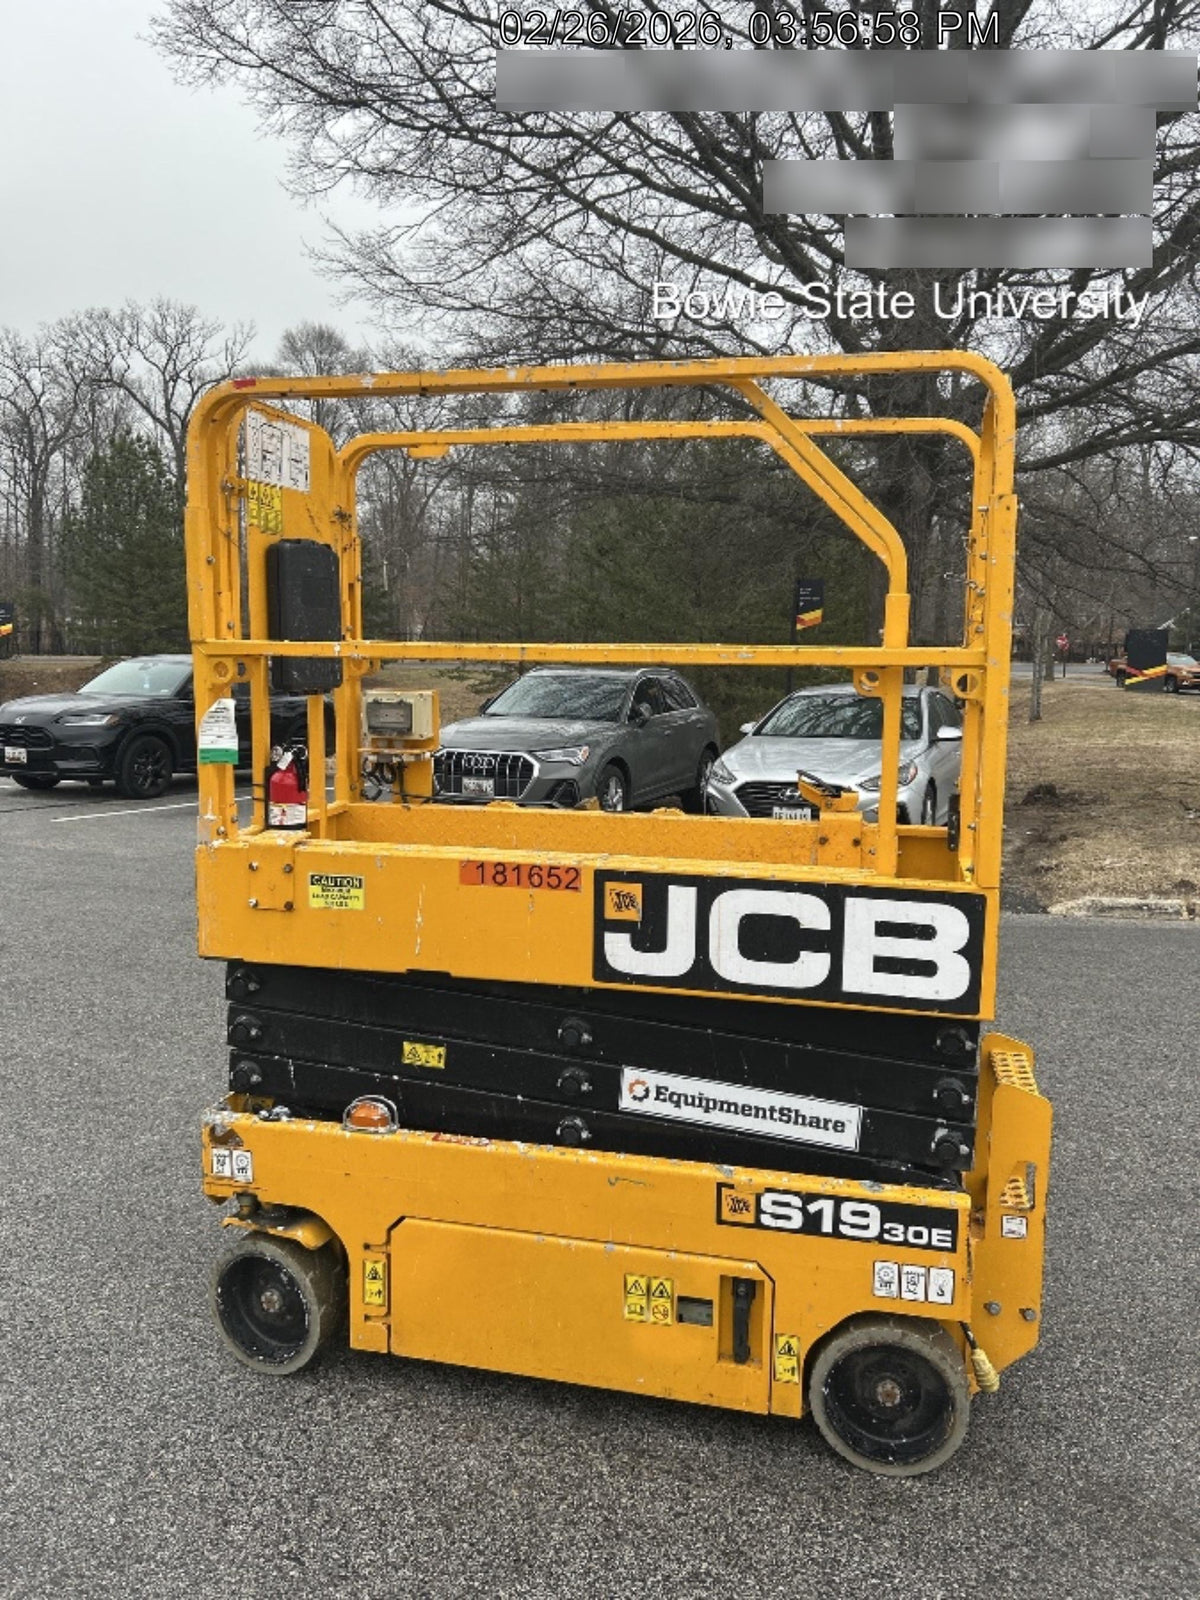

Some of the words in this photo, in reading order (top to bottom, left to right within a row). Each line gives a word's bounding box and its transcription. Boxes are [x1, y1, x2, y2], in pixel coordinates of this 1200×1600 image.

[312, 875, 361, 888] CAUTION
[475, 861, 580, 891] 181652
[603, 884, 972, 1002] JCB
[653, 1084, 847, 1134] EquipmentShare
